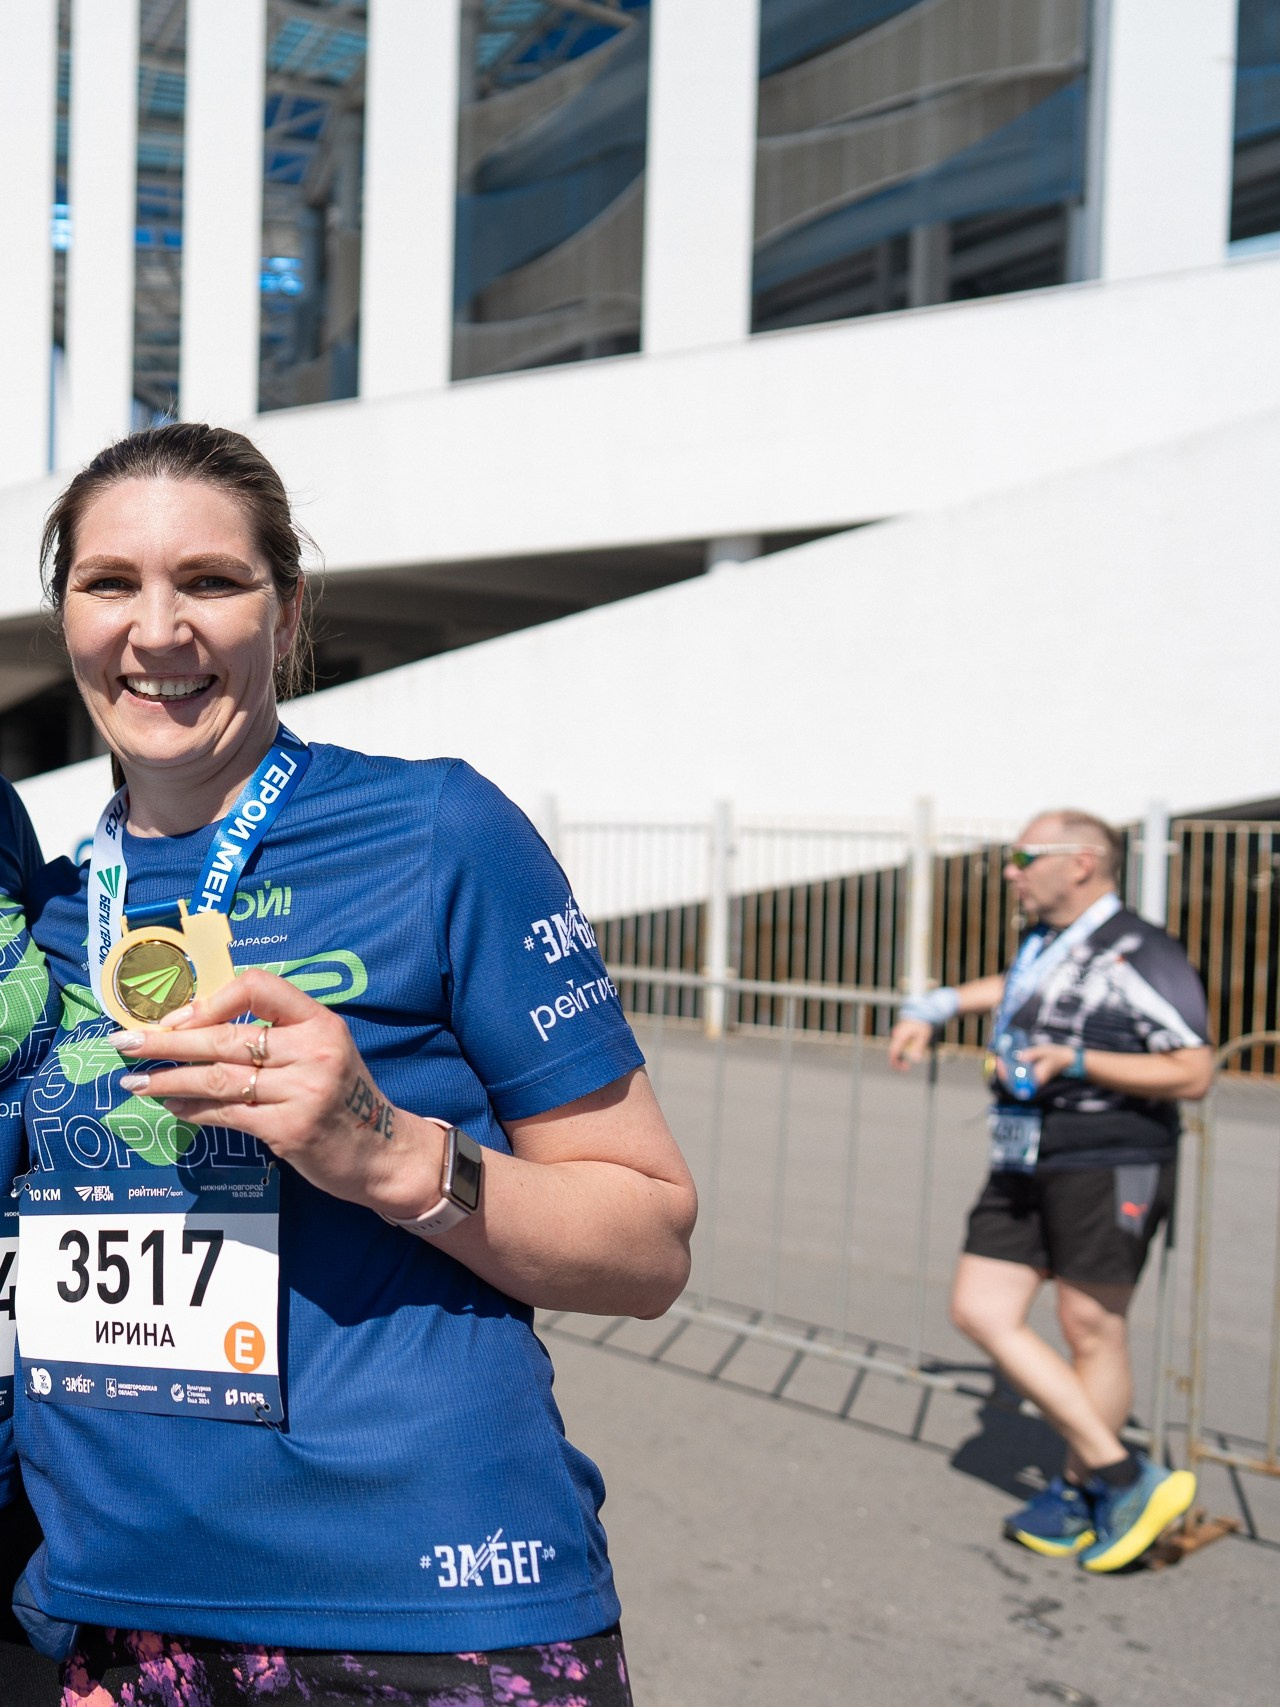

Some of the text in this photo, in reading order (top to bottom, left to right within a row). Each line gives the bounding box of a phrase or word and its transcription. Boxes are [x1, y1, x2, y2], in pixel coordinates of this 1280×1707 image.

[106, 798, 124, 841] ПСБ
[195, 751, 298, 916] ГЕРОИ МЕН
[230, 880, 293, 922] ОЙ!
[227, 934, 288, 949] МАРАФОН
[529, 976, 618, 1042] рейтин
[29, 1188, 61, 1201] 10 КМ
[229, 1184, 264, 1192] НОВГОРОД
[57, 1229, 224, 1307] 3517
[95, 1321, 175, 1348] ИРИНА
[239, 1391, 266, 1405] ПСБ
